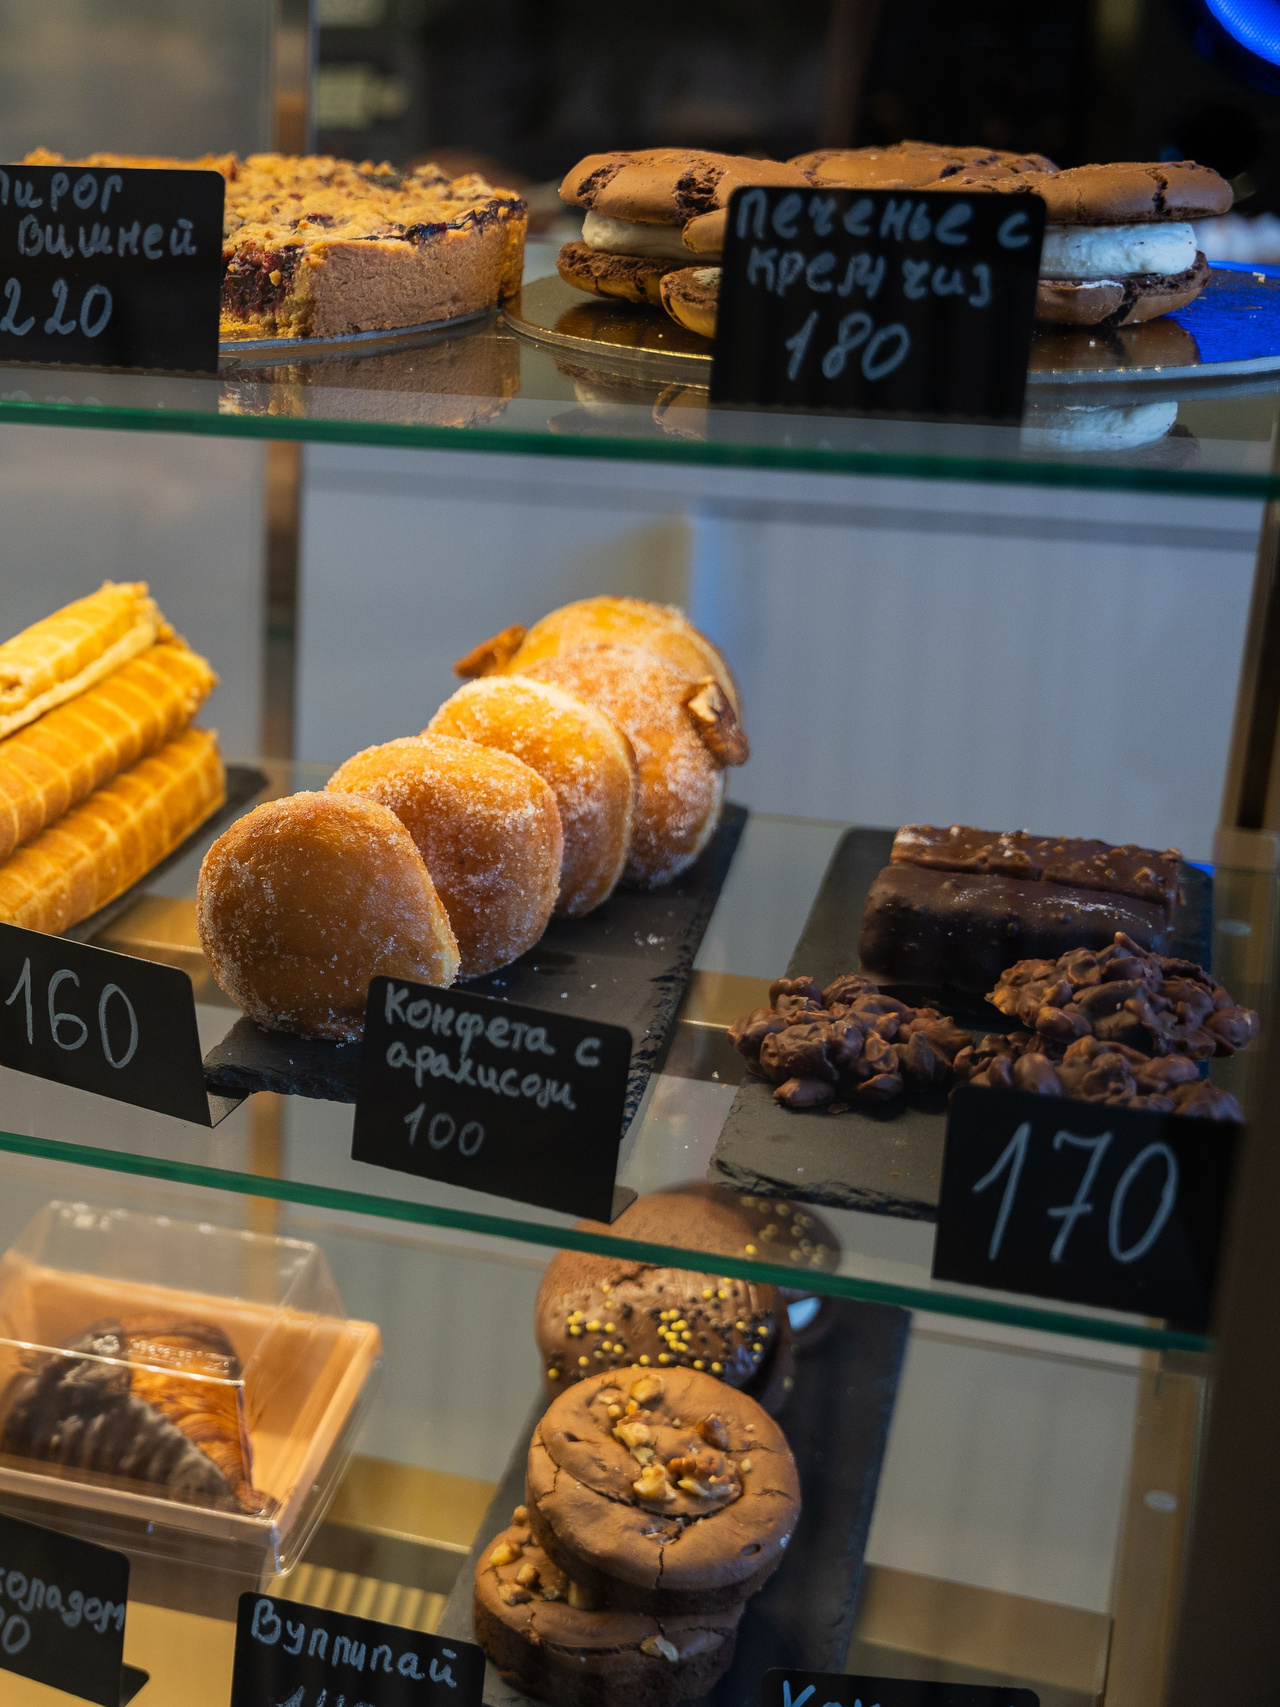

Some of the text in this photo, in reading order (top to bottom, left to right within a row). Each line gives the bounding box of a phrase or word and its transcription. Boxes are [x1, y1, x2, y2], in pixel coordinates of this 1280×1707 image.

[737, 188, 974, 246] Печенье
[0, 277, 113, 338] 220
[785, 310, 910, 381] 180
[5, 957, 139, 1069] 160
[385, 982, 556, 1063] Конфета
[386, 1041, 576, 1110] арахисом
[404, 1102, 484, 1155] 100
[972, 1121, 1179, 1264] 170
[251, 1598, 457, 1687] Вуппипай
